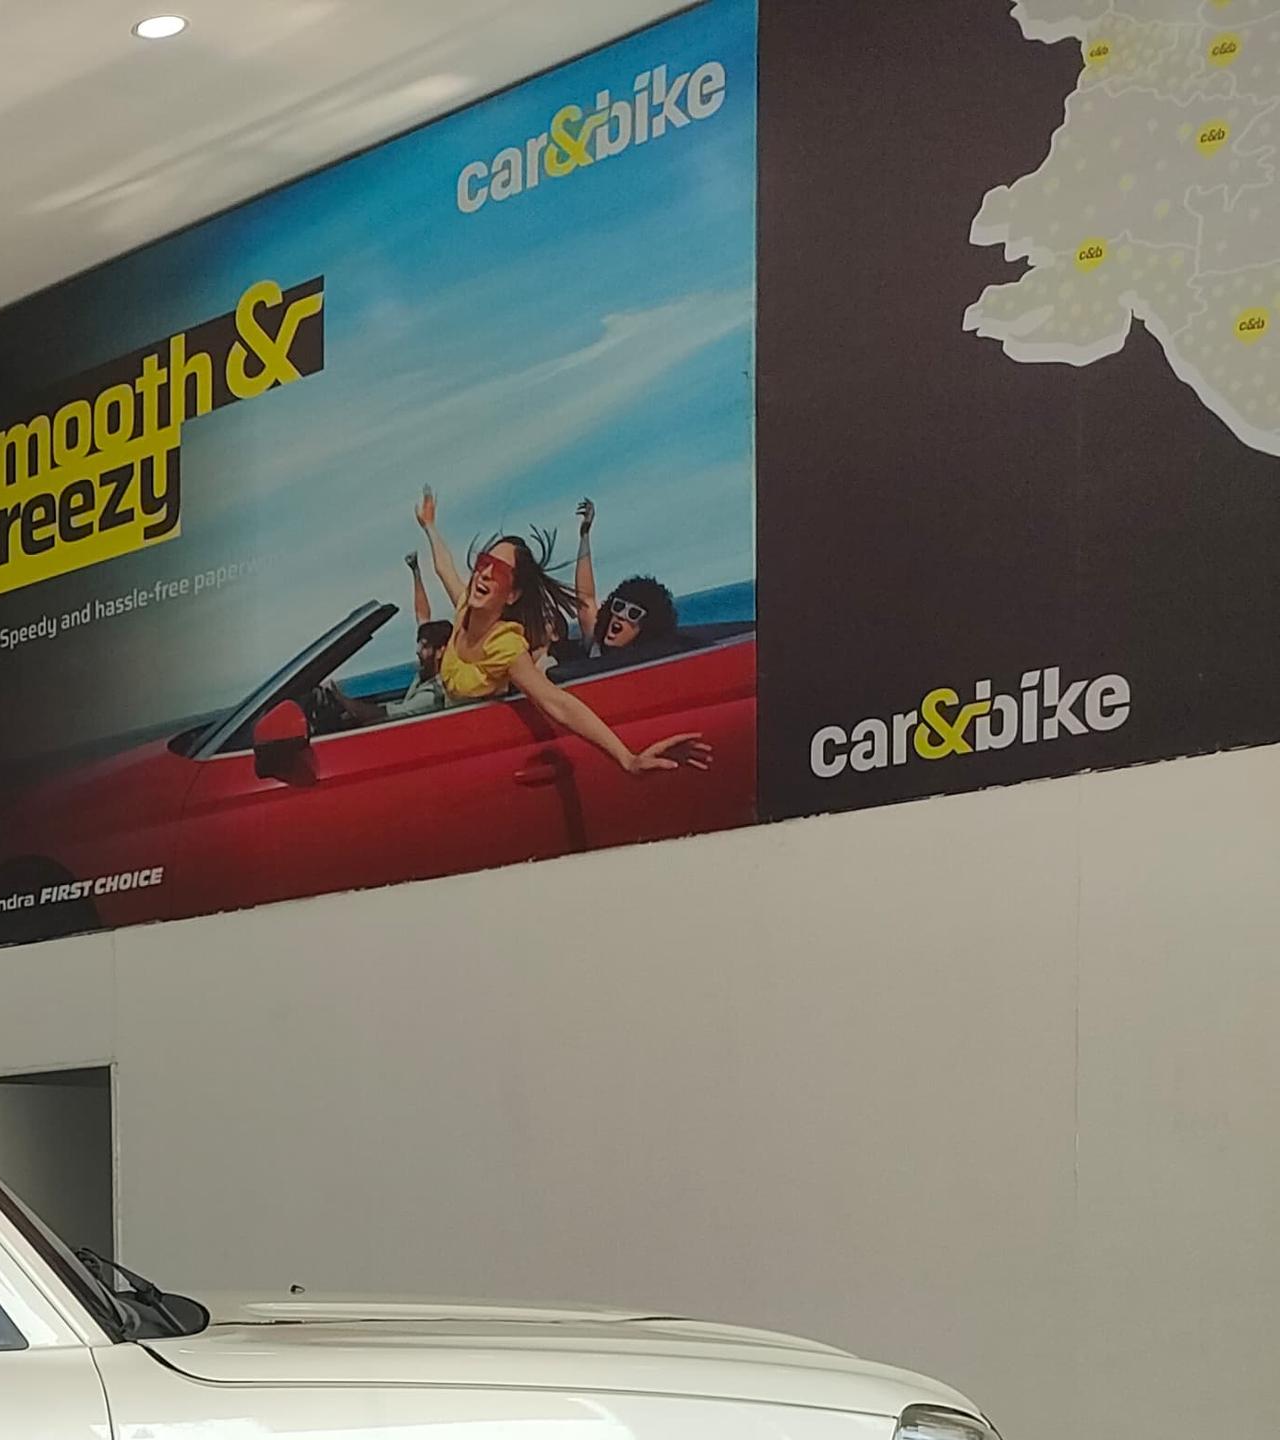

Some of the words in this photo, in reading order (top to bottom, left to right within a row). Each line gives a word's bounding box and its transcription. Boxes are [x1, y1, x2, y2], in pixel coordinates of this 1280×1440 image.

[456, 60, 726, 214] car&bike
[225, 280, 324, 400] &
[0, 614, 58, 650] Speedy
[61, 603, 91, 630] and
[95, 581, 190, 620] hassle-free
[810, 666, 1131, 778] car&bike
[40, 880, 93, 905] FIRST
[94, 867, 164, 895] CHOICE
